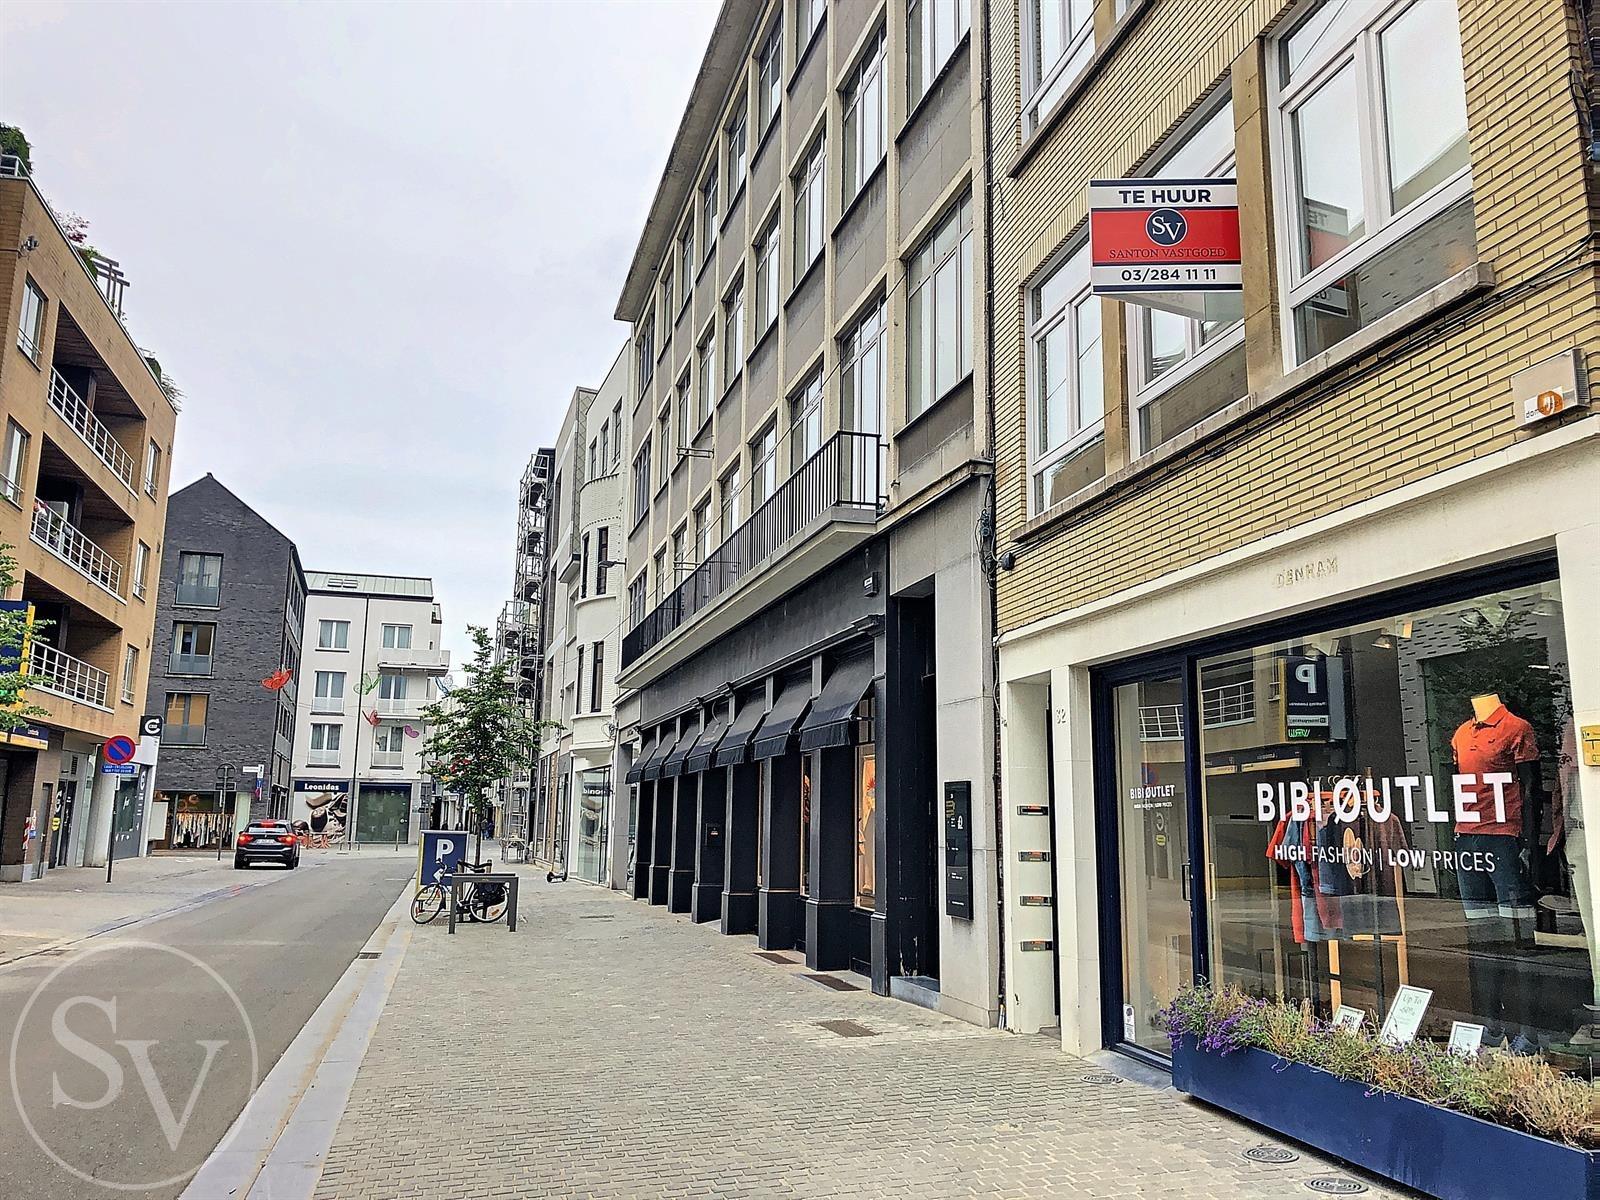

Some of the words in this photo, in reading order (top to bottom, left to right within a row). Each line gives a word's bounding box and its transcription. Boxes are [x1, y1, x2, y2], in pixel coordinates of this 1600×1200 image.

[1119, 190, 1145, 203] TE
[1152, 189, 1212, 203] HUUR
[1152, 216, 1183, 241] SV
[1109, 248, 1159, 259] SANTON
[1160, 247, 1226, 258] VASTGOED
[1121, 268, 1180, 283] 03/284
[1186, 268, 1198, 280] 11
[1204, 268, 1216, 280] 11
[304, 783, 340, 791] Leonidas
[1130, 788, 1144, 800] BIBI
[1256, 780, 1323, 822] BIBI
[1333, 772, 1512, 824] ØUTLET
[435, 838, 455, 863] P
[1274, 844, 1306, 861] HIGH
[1311, 846, 1373, 866] FASHION
[1388, 850, 1426, 869] LOW
[1432, 850, 1496, 872] PRICES
